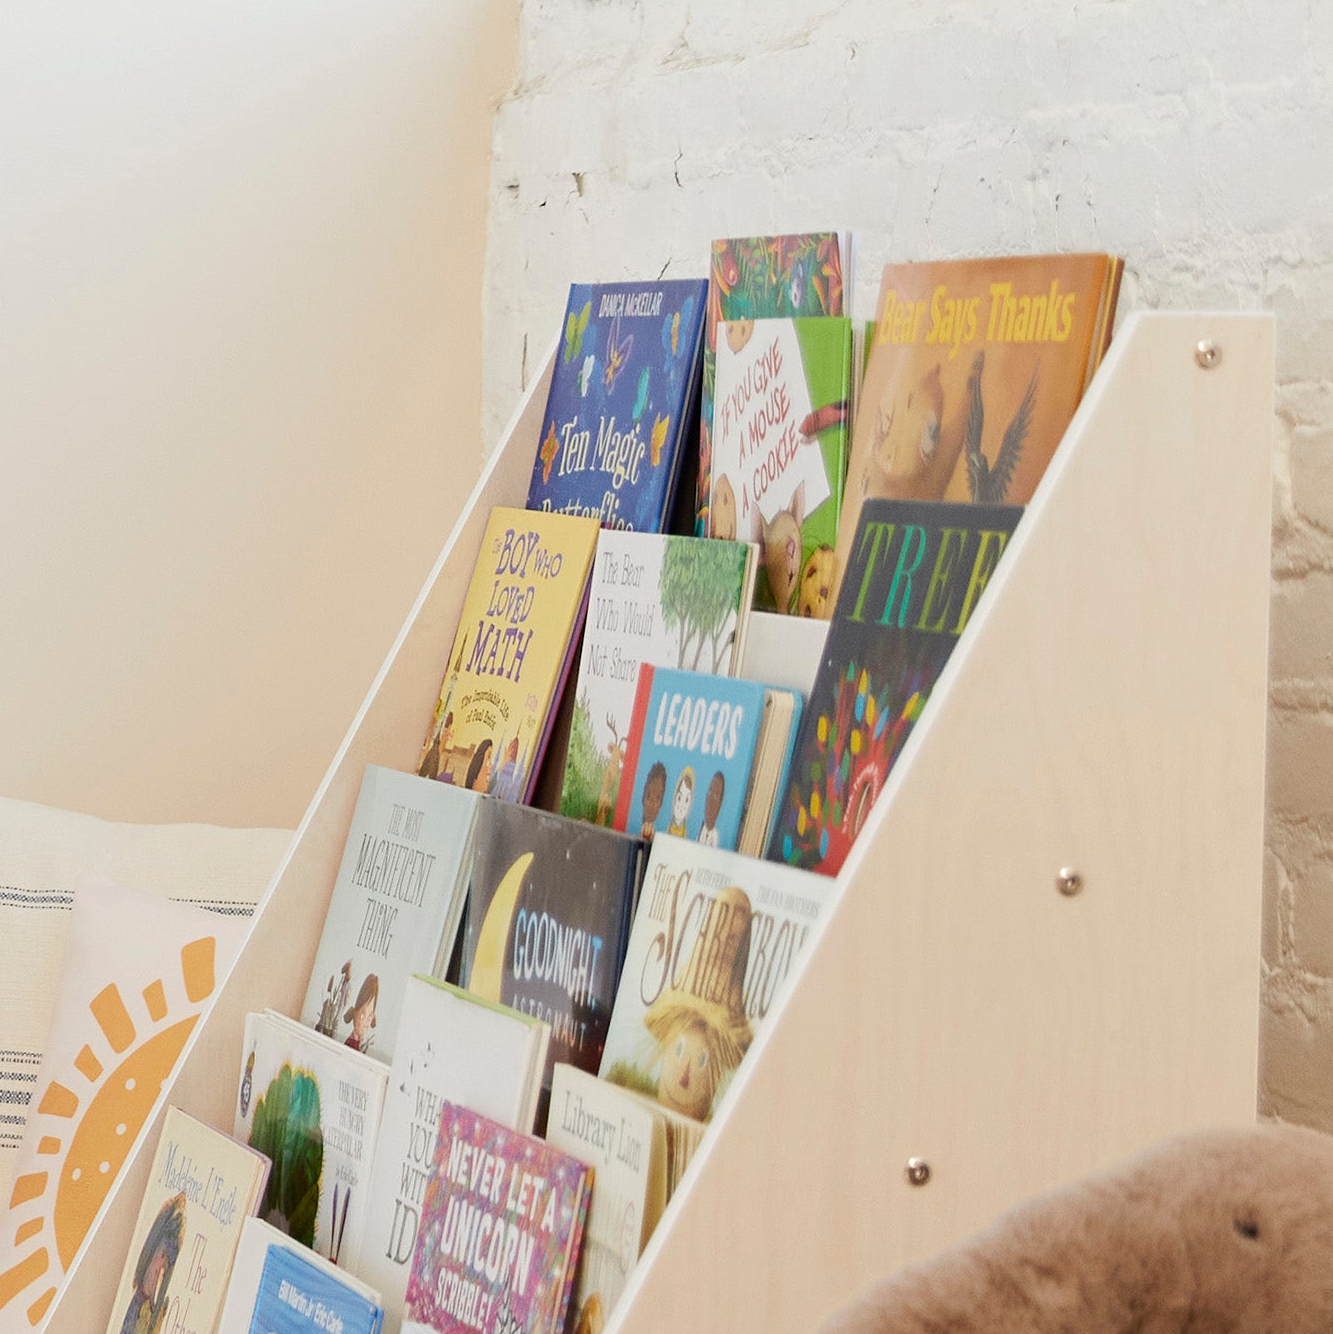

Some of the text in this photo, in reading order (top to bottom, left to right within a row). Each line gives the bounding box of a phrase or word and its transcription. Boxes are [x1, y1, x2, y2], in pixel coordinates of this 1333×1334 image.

[879, 278, 1075, 360] Bear Says Thanks
[732, 367, 751, 421] YOU
[754, 337, 783, 397] GIVE
[558, 415, 645, 489] Ten Magic
[739, 382, 791, 467] A MOUSE
[743, 419, 799, 518] A COOKIE
[495, 528, 540, 579] BOY
[533, 548, 563, 579] WHO
[602, 551, 644, 588] The Bear
[486, 579, 535, 624] LOVED
[596, 597, 655, 637] Who Would
[466, 620, 534, 683] MATH
[587, 644, 637, 682] Not Share
[654, 691, 742, 760] LEADERS
[351, 833, 436, 908] MAGNIFICENT
[357, 898, 398, 957] THING
[561, 1089, 641, 1172] Library Lion
[446, 1135, 557, 1233] NEVER LET A
[184, 1232, 207, 1295] The
[440, 1195, 534, 1296] UNICORN
